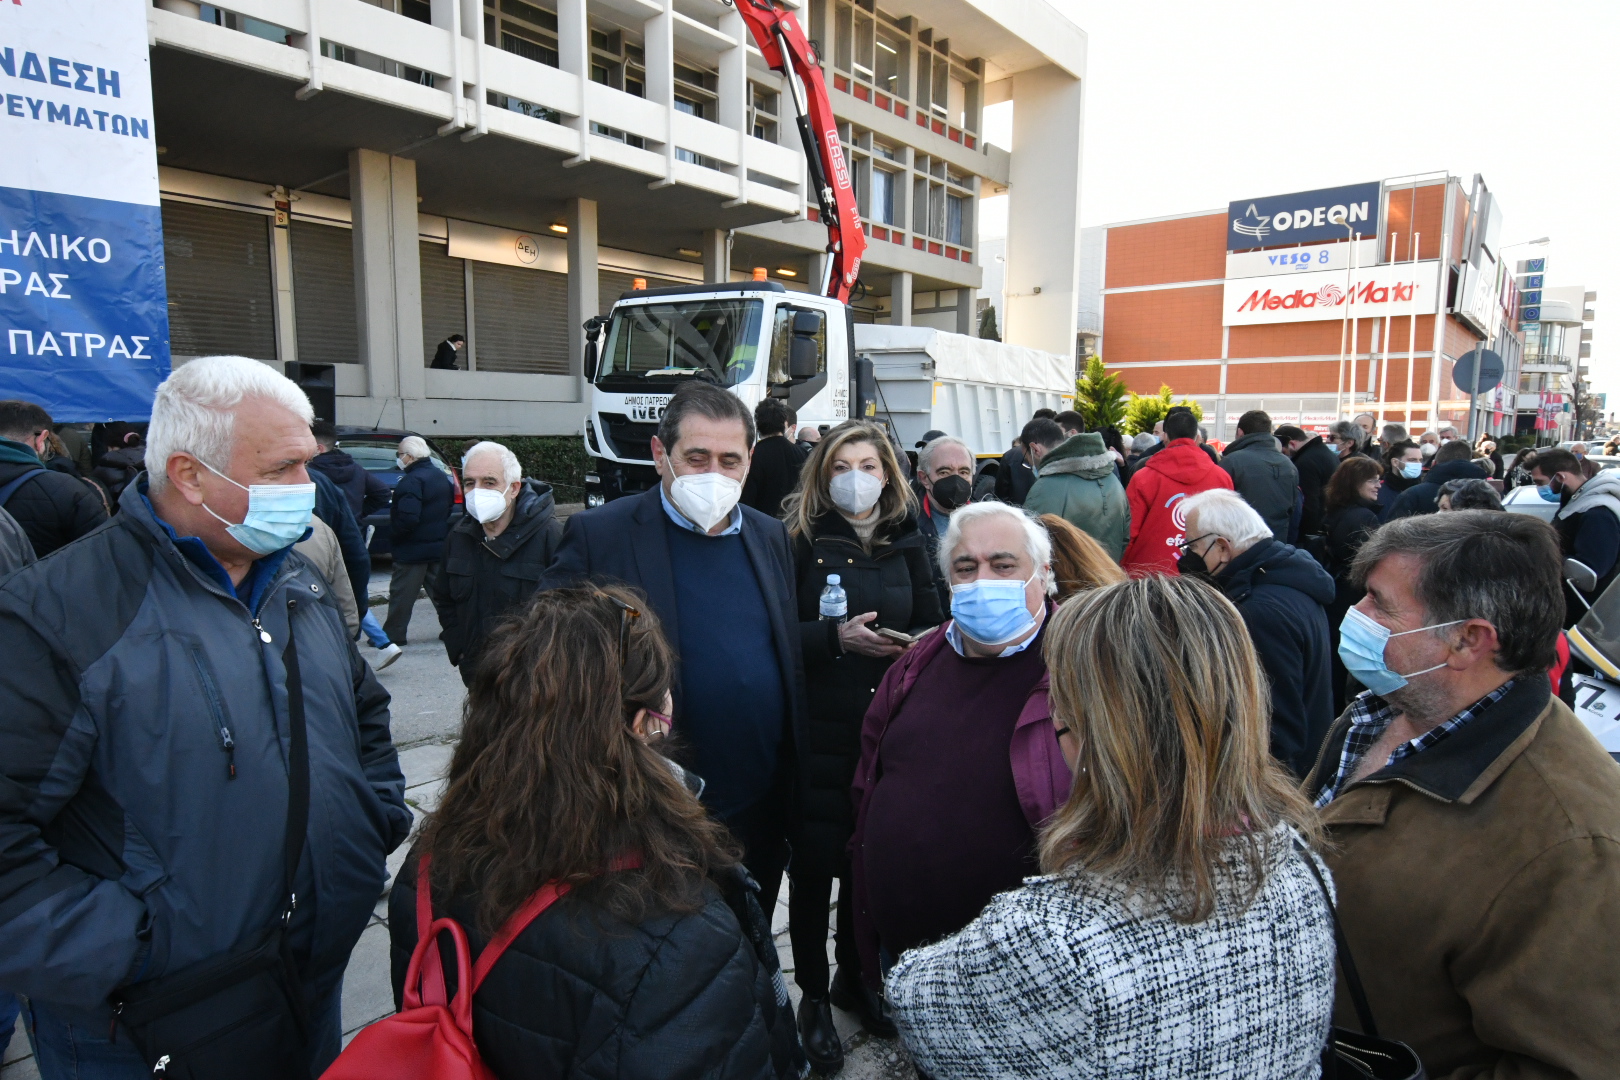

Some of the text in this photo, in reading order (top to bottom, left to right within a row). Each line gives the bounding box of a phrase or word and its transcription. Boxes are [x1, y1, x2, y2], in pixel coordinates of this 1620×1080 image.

[0, 92, 150, 140] ΕΥΜΑΤΩΝ
[827, 132, 850, 189] FASSI
[1272, 201, 1369, 232] ODEON
[0, 229, 112, 264] ΗΛΙΚΟ
[1268, 249, 1330, 266] VESO 8
[1236, 288, 1318, 313] Media
[8, 329, 152, 360] ΠΑΤΡΑΣ
[632, 405, 666, 420] IVEC
